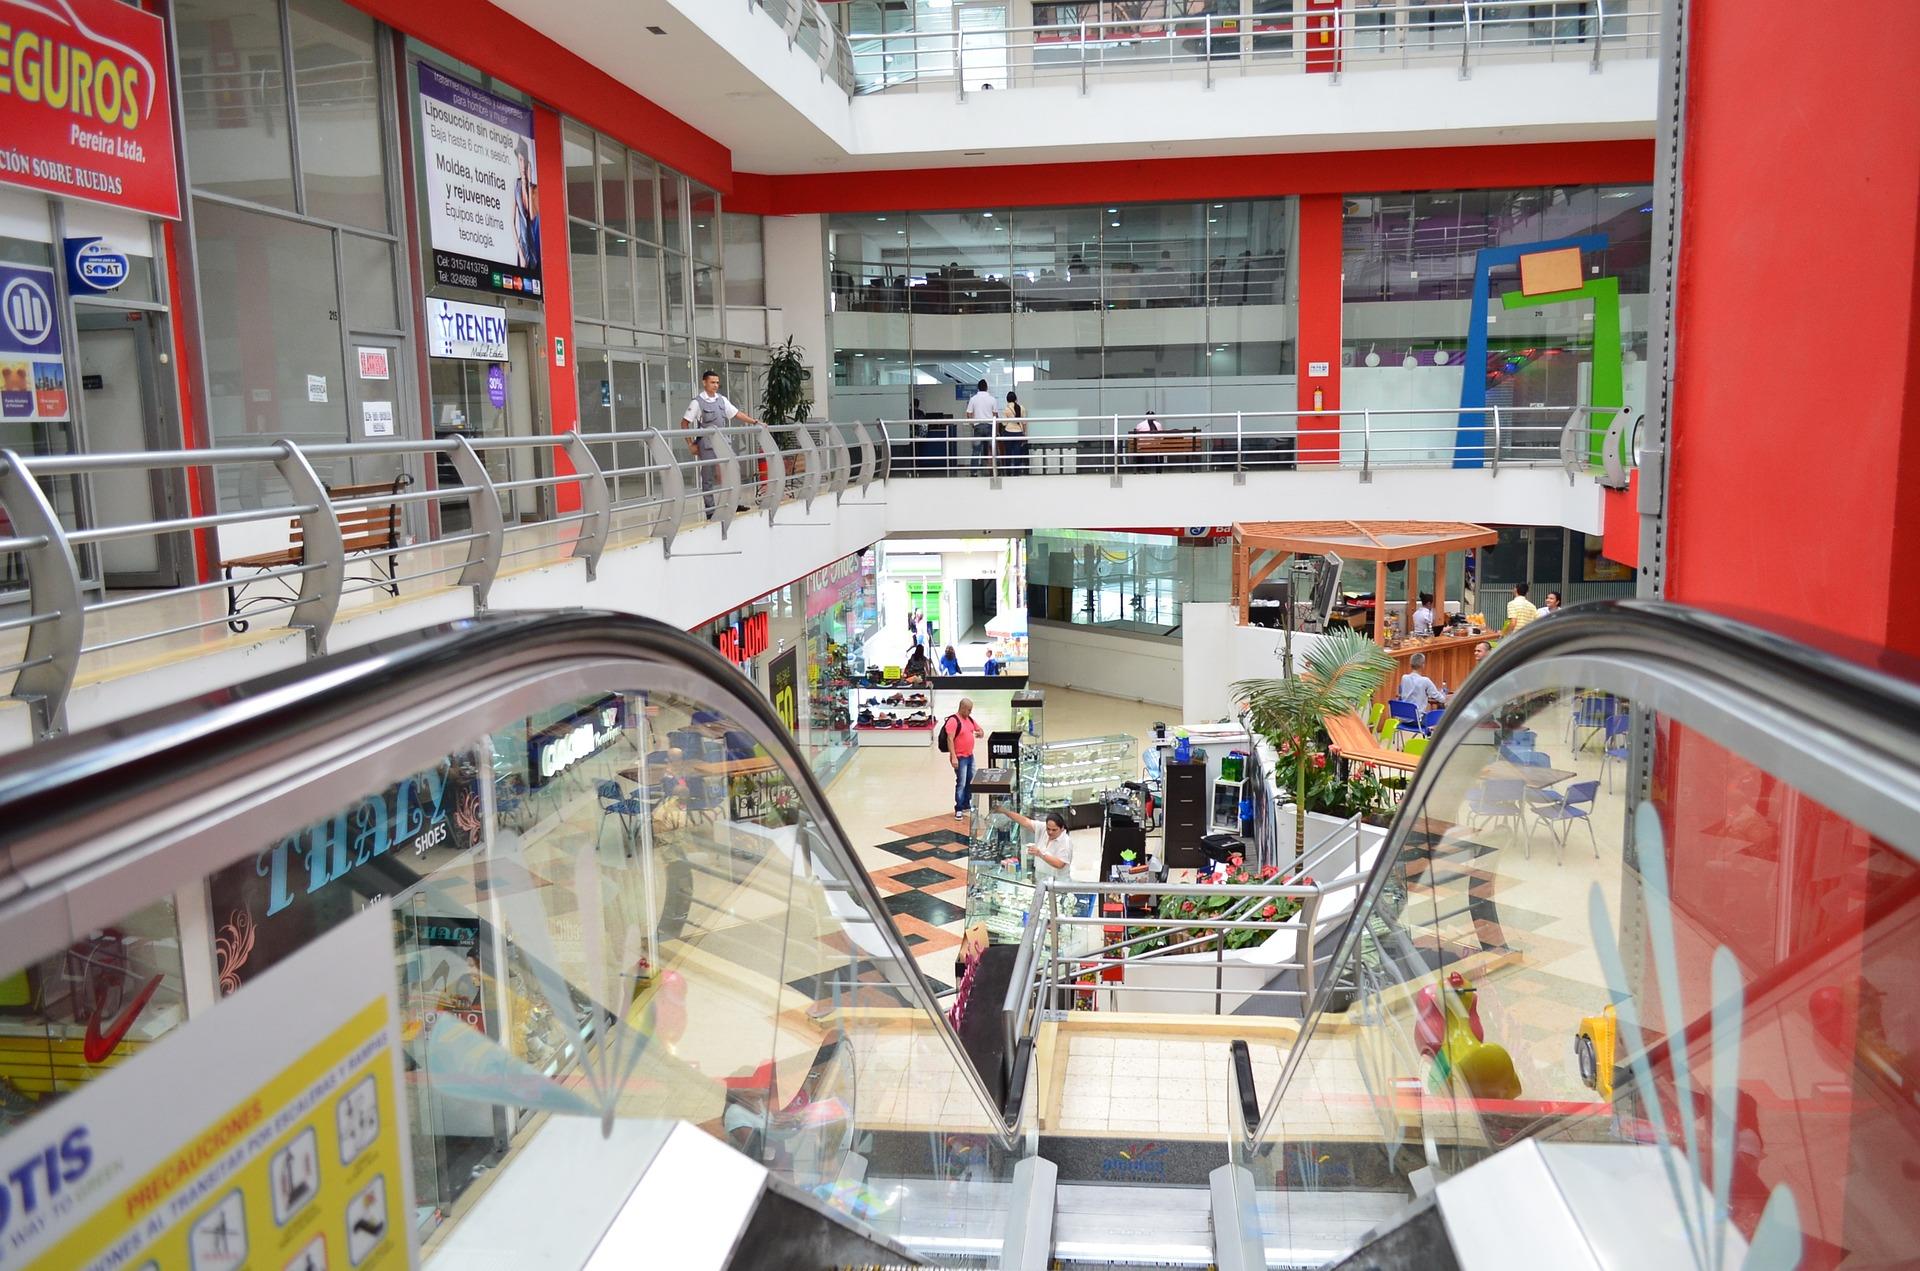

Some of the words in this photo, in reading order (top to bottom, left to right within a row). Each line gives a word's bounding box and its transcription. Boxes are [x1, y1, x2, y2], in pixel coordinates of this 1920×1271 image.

[453, 94, 467, 108] para
[425, 100, 475, 132] Liposucción
[476, 122, 488, 138] sin
[71, 124, 115, 154] Pereira
[117, 136, 146, 163] Ltda.
[430, 124, 447, 144] Baja
[448, 131, 467, 149] hasta
[467, 141, 473, 151] 6
[473, 145, 485, 156] cm
[33, 157, 74, 186] SOBRE
[76, 168, 123, 195] RUEDAS
[436, 153, 474, 183] Moldea,
[475, 166, 506, 191] tonifica
[446, 183, 452, 198] y
[454, 186, 501, 210] rejuvenece
[445, 202, 474, 223] Equipos
[475, 213, 484, 225] de
[485, 213, 504, 230] última
[456, 313, 507, 344] RENEW
[489, 377, 503, 390] 30%
[719, 627, 739, 667] BIG
[742, 611, 769, 661] JOHN
[992, 744, 1013, 754] STORM
[256, 756, 451, 917] THALY
[415, 823, 447, 855] SHOES
[127, 1098, 262, 1220] PRECAUCIONES
